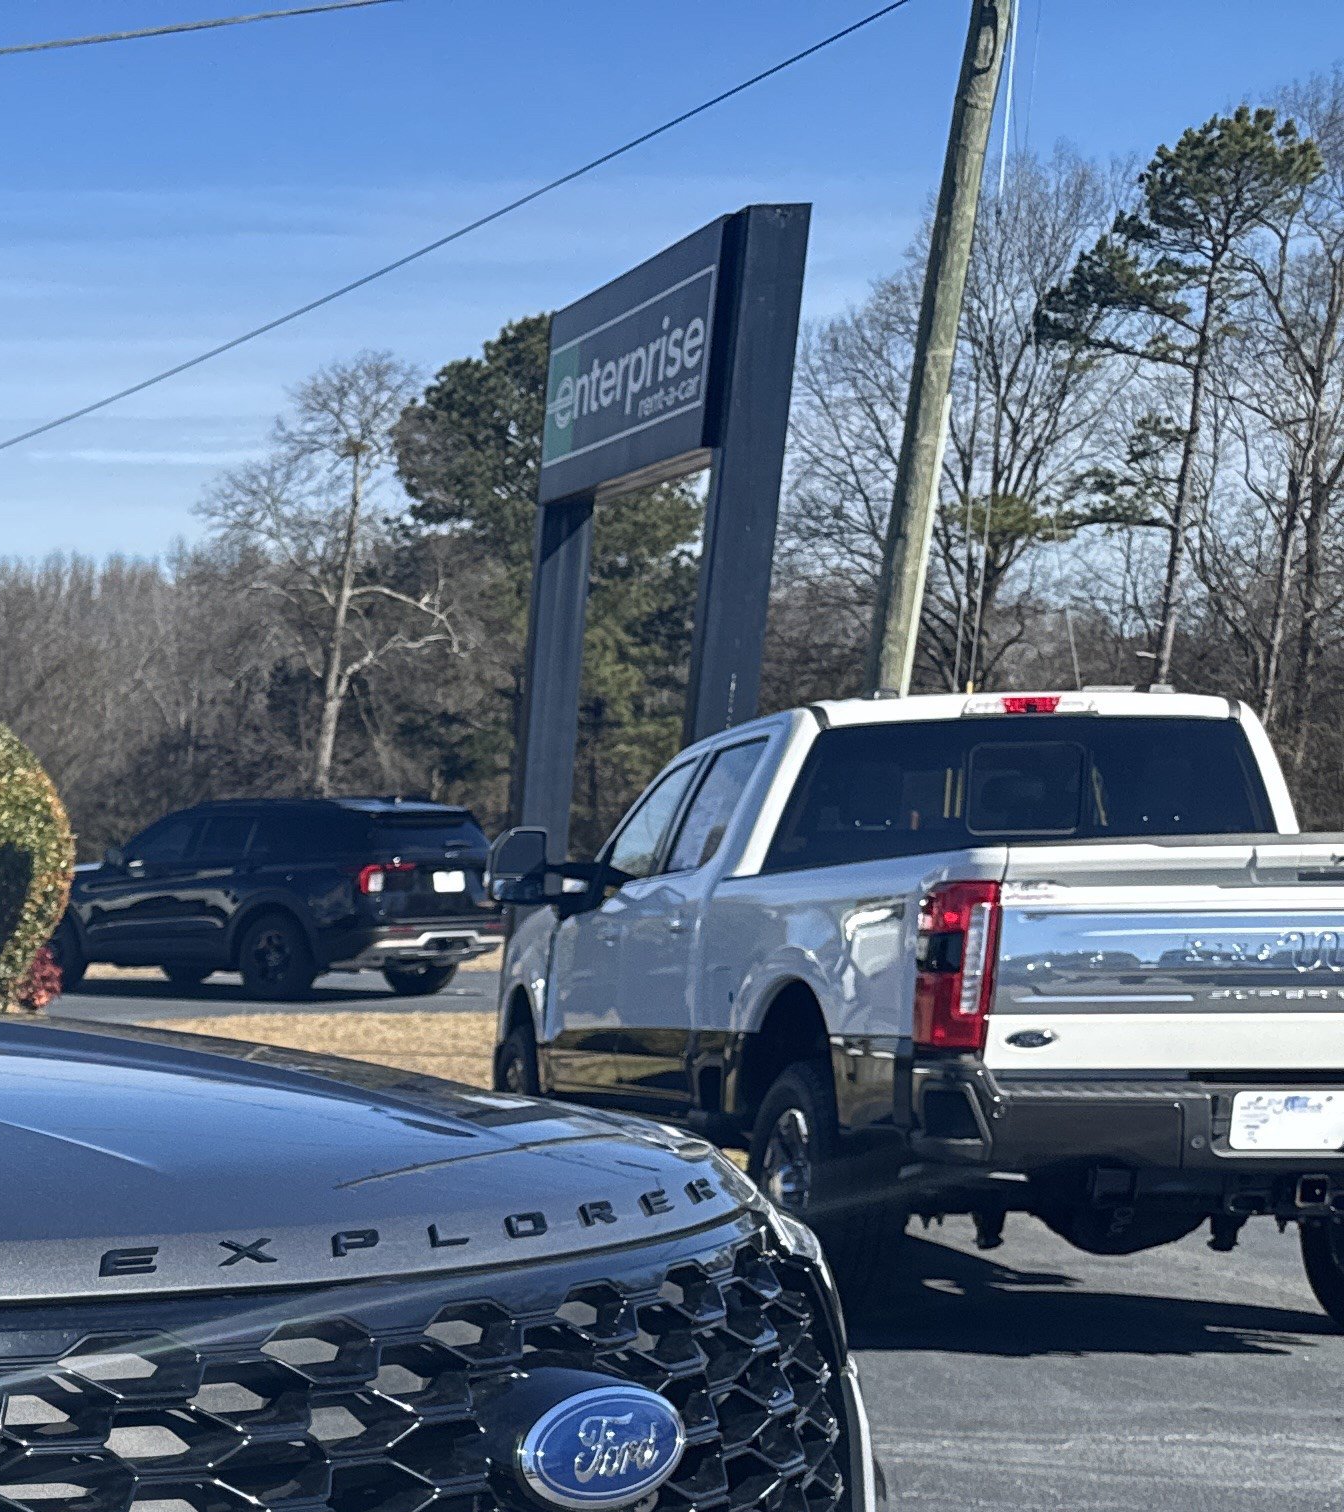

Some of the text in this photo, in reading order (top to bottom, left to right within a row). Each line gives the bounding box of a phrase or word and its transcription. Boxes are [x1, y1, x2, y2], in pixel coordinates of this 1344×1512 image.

[554, 316, 706, 429] enterprise
[98, 1177, 719, 1278] EXPLORER
[574, 1411, 659, 1483] Ford
